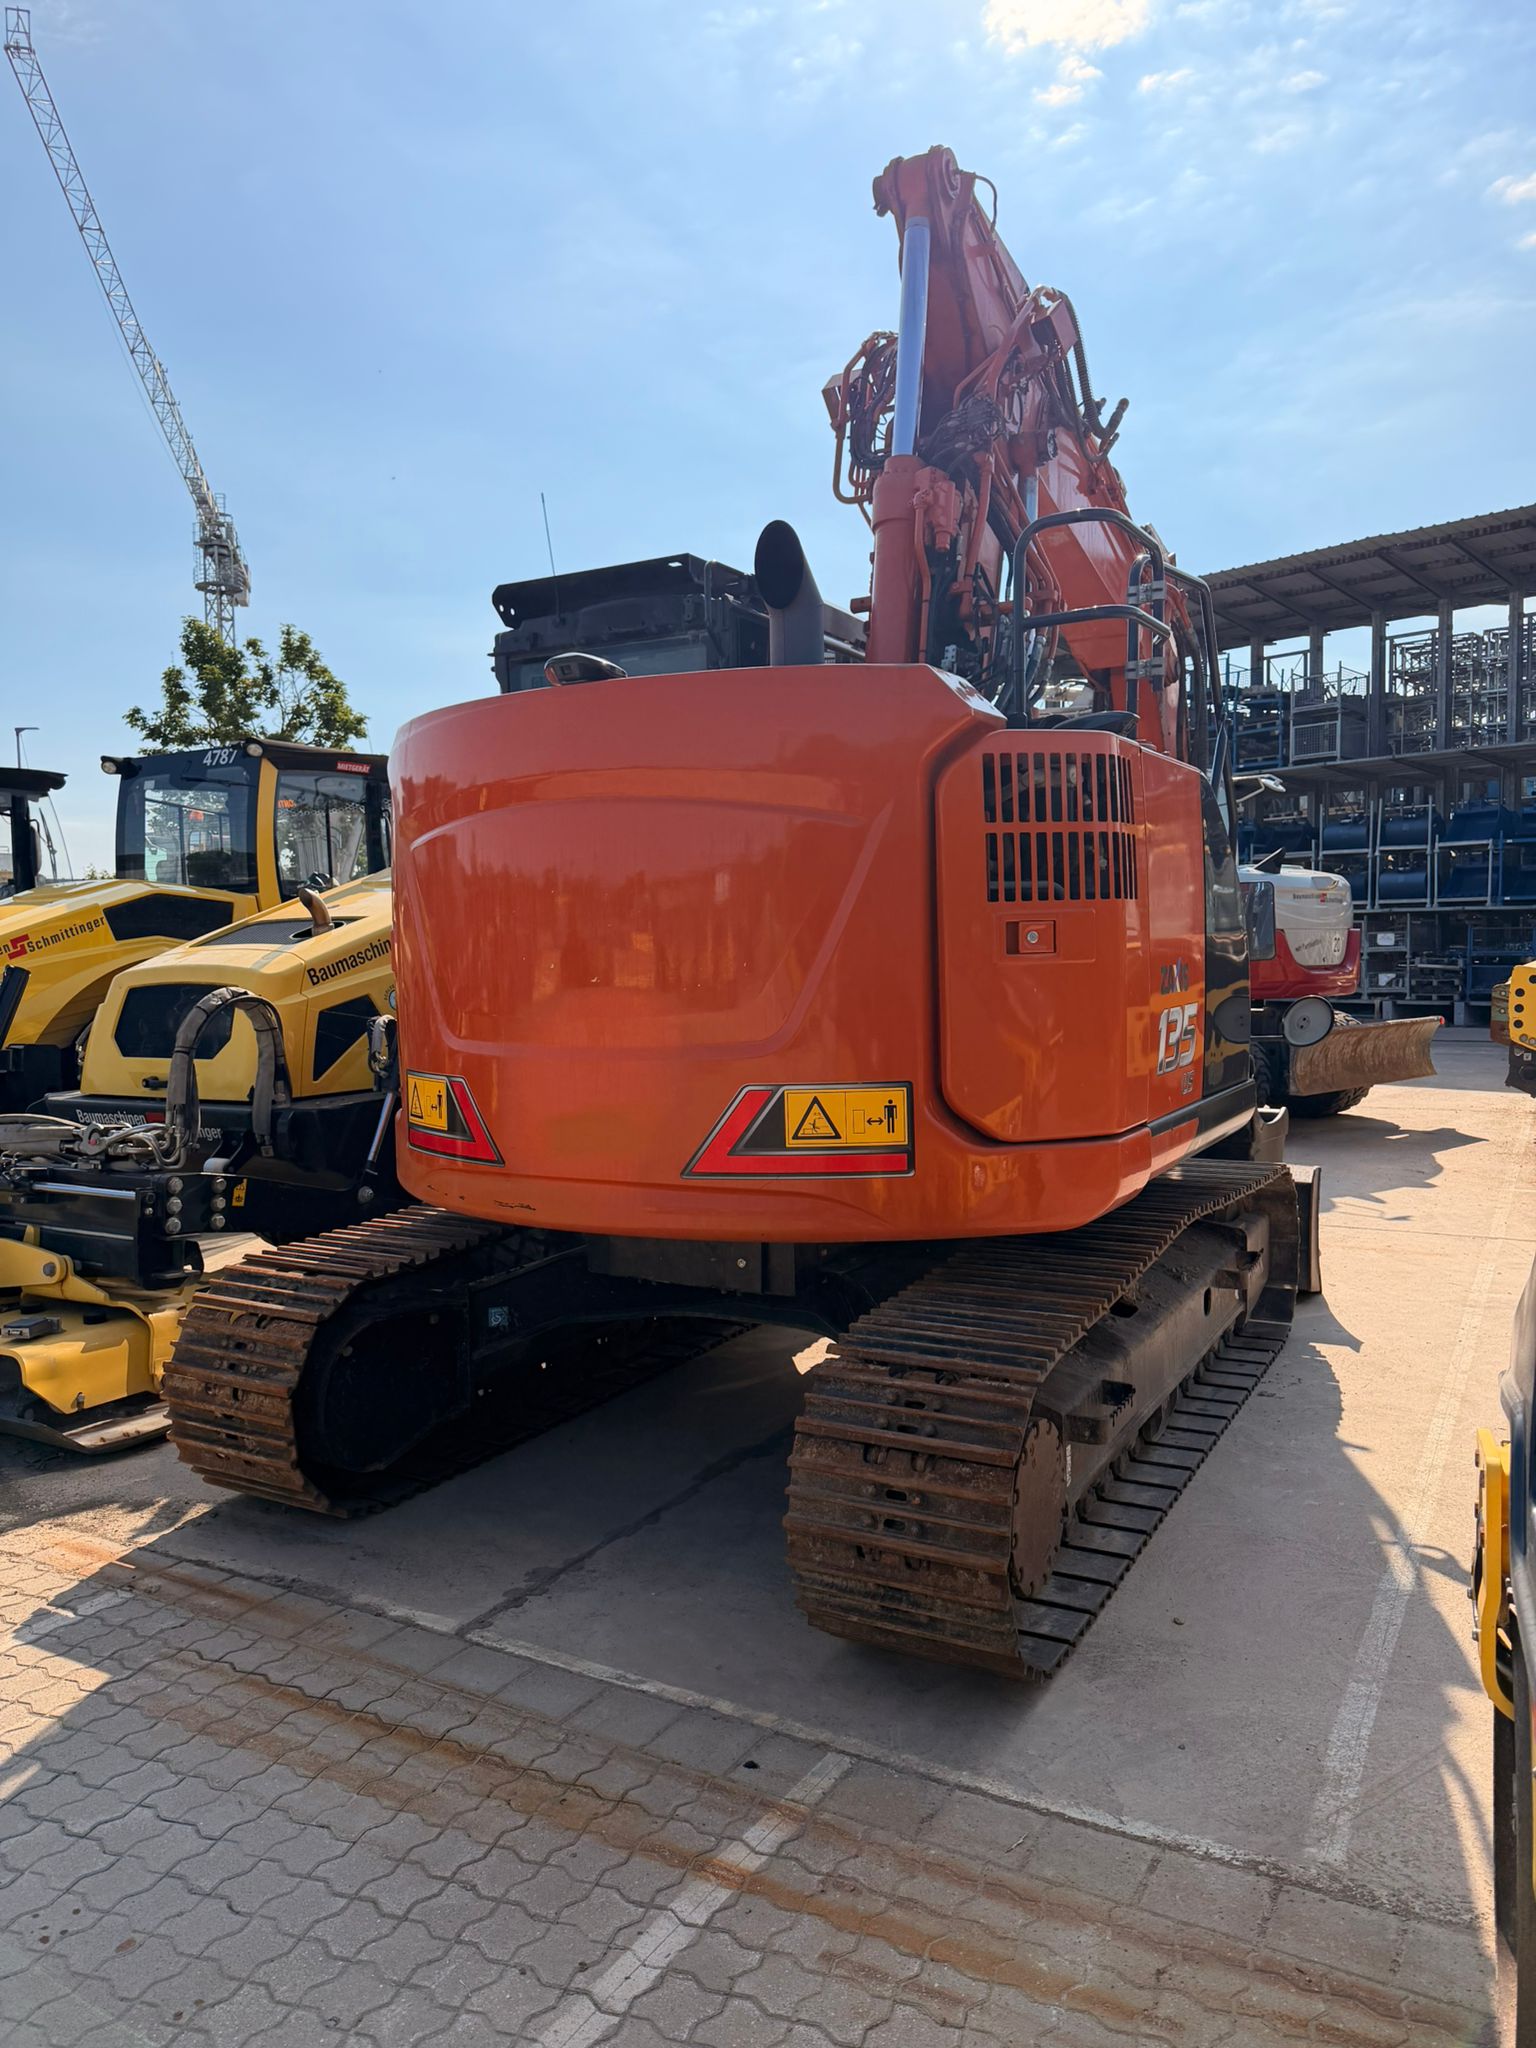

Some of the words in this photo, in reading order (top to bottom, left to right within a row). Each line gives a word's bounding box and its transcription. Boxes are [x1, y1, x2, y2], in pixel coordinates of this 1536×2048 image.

[203, 748, 237, 766] 4787
[27, 916, 105, 952] Schmittinger
[1156, 1002, 1199, 1077] 135
[76, 1109, 147, 1126] Baumaschinen
